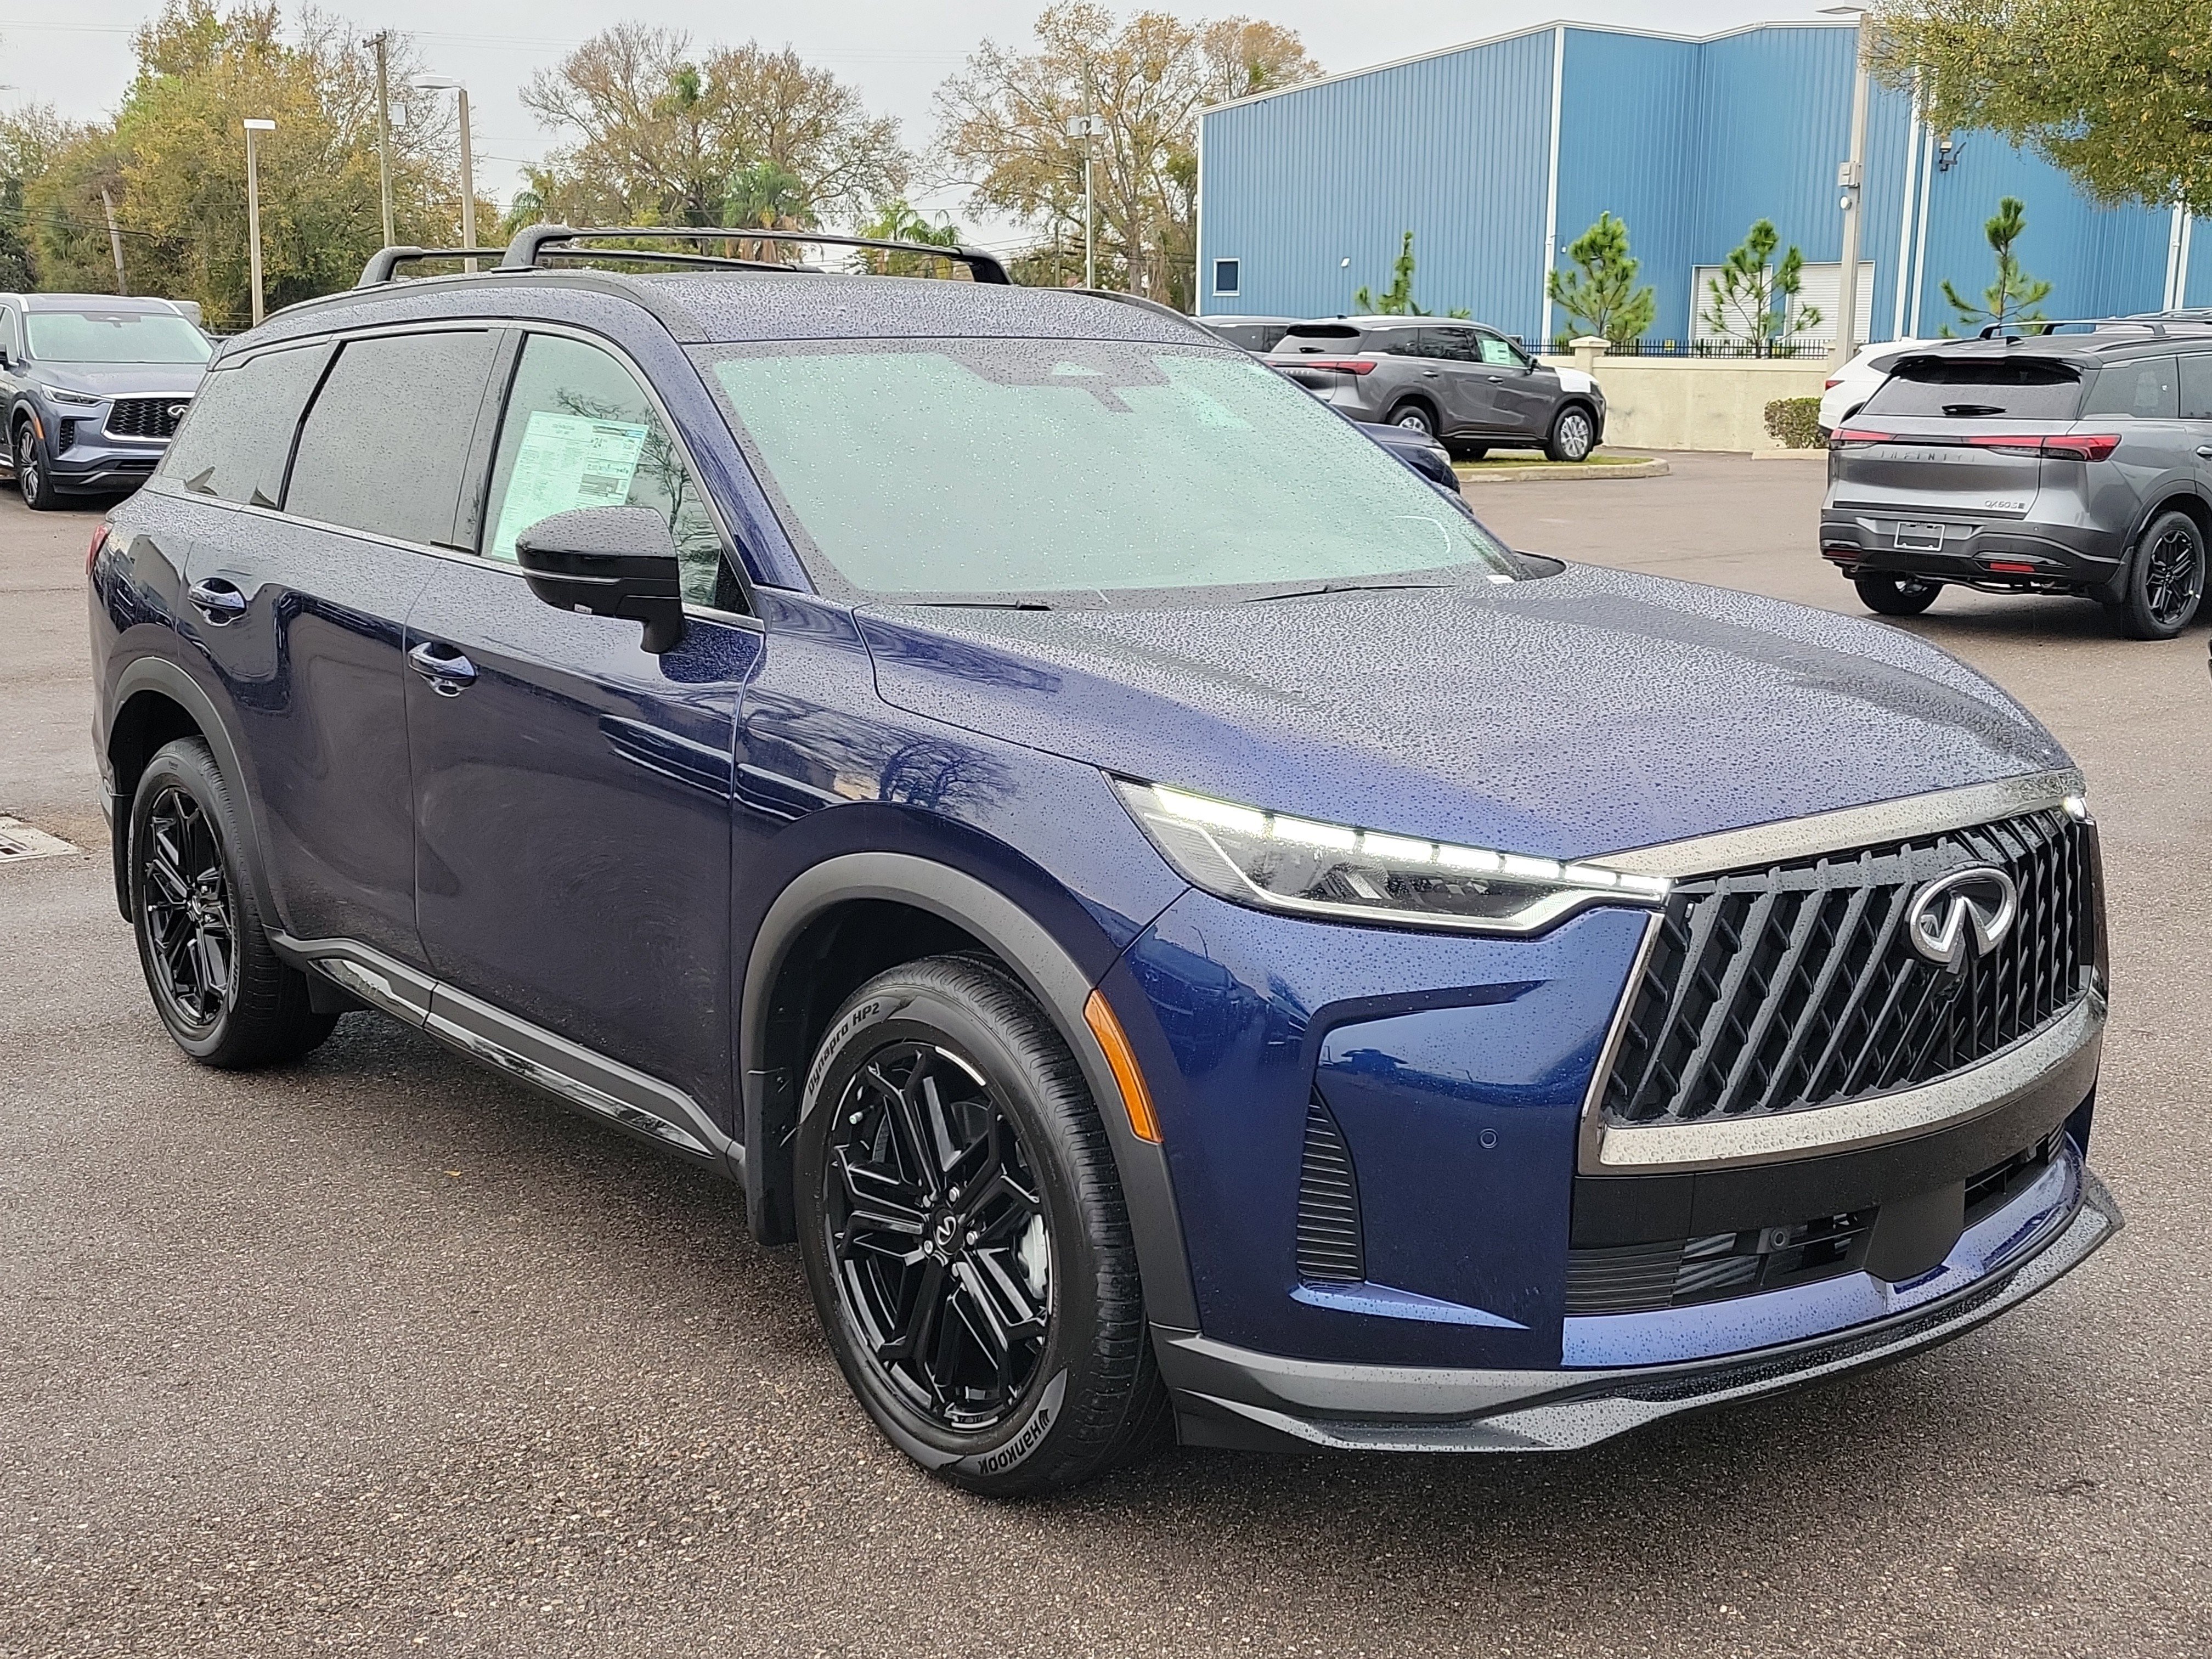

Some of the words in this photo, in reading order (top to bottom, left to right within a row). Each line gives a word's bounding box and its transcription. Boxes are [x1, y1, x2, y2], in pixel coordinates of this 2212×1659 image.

[1880, 450, 1975, 462] INFINITI
[808, 1022, 849, 1096] Dynapro
[852, 1002, 880, 1026] HP2
